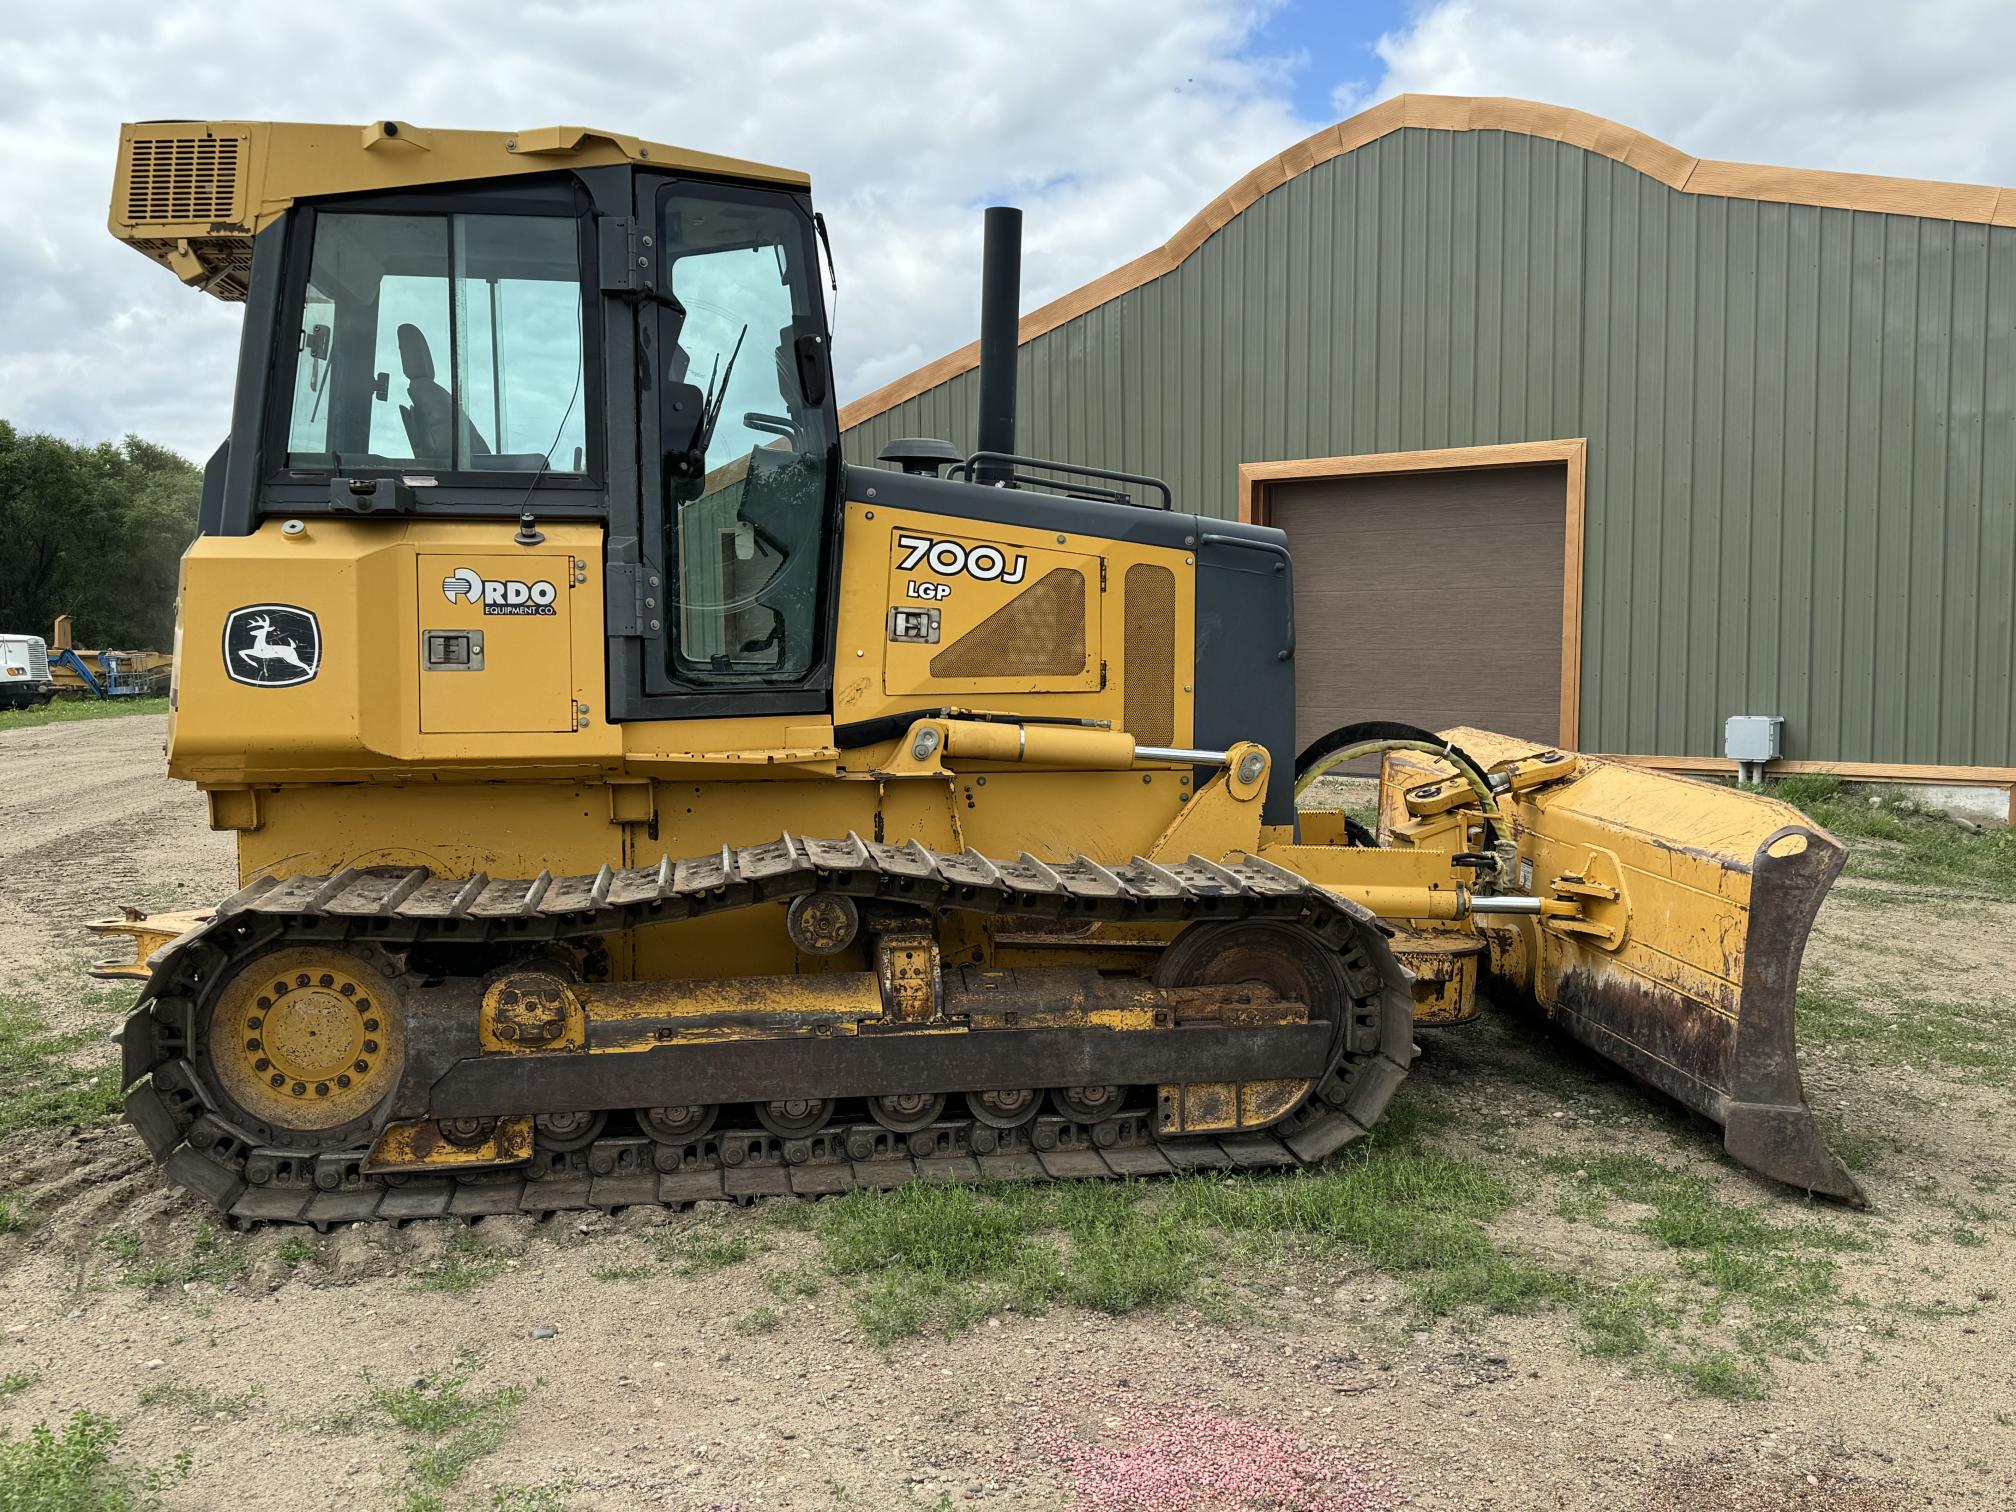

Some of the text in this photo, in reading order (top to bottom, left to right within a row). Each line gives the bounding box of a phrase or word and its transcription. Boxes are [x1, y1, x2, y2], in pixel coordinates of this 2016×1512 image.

[896, 535, 1027, 583] 700J
[484, 580, 556, 605] RDO
[907, 580, 951, 600] LGP
[485, 606, 556, 615] EQUIPMENT CO.
